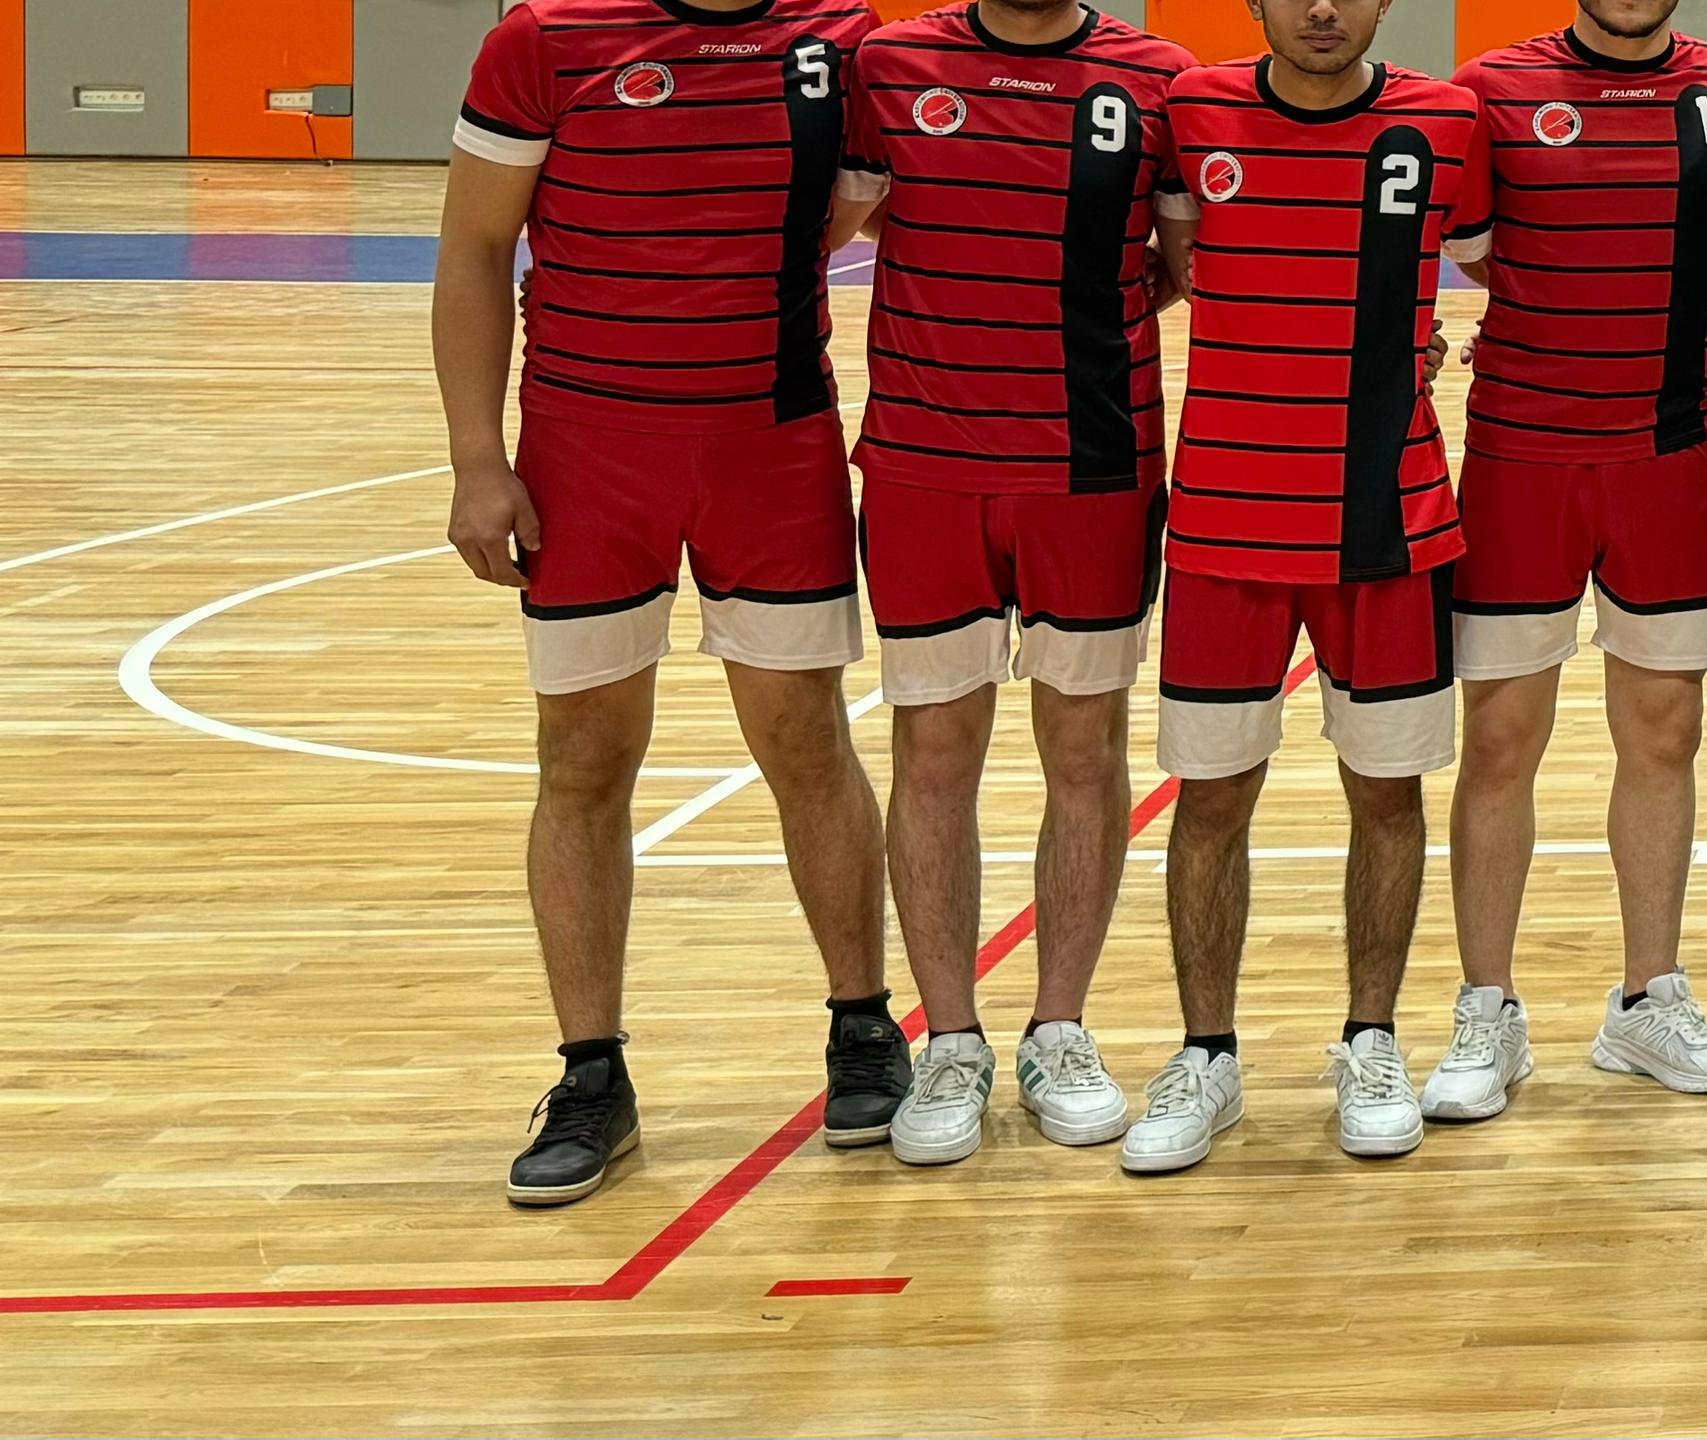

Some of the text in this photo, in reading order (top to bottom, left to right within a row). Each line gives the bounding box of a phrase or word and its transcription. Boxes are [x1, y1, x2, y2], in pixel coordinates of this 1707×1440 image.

[698, 44, 761, 54] STARION
[795, 43, 829, 99] 5
[988, 76, 1056, 93] STARION
[1600, 89, 1656, 99] STARION
[1091, 95, 1126, 153] 9
[1379, 153, 1420, 215] 2
